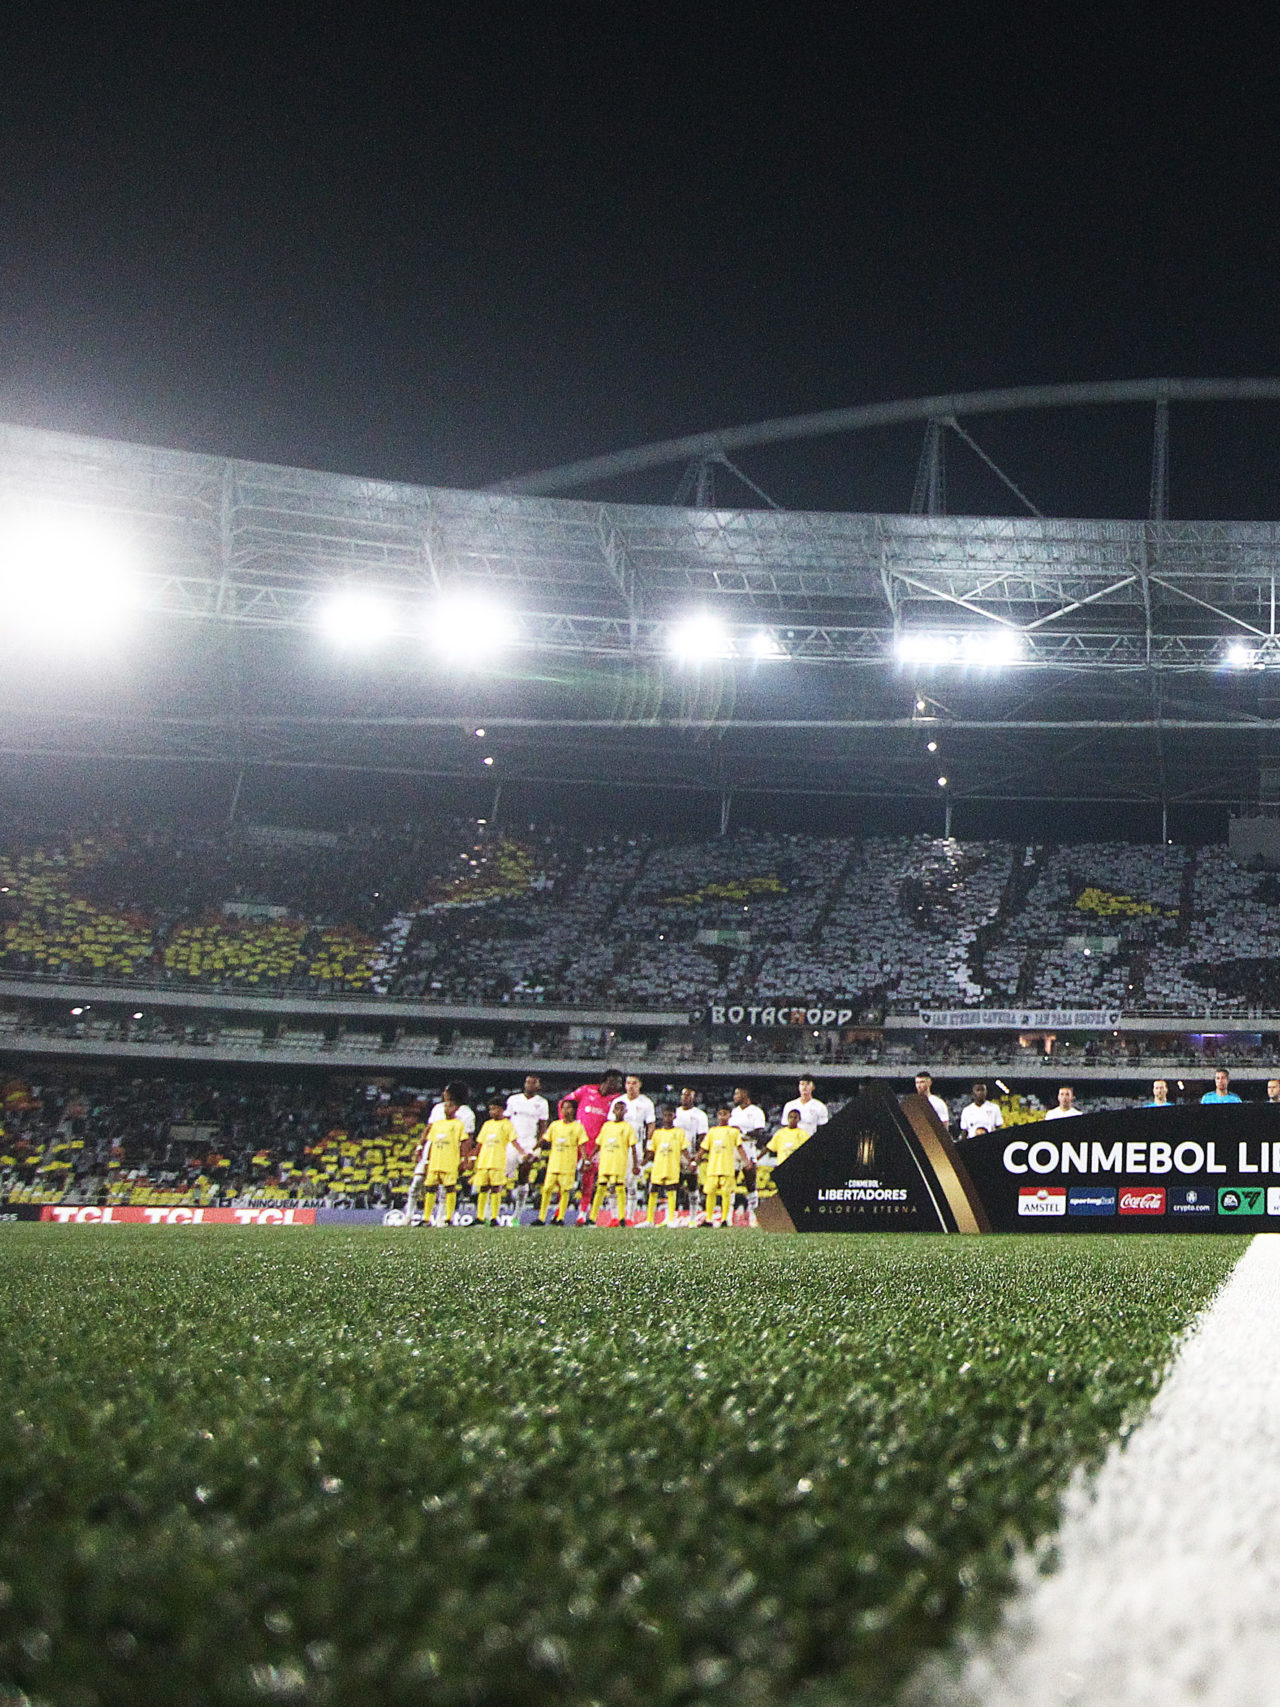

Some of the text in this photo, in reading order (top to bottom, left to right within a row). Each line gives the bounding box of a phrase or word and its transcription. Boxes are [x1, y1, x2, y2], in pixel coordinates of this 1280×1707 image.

[1003, 1141, 1227, 1174] CONMEBOL
[818, 1189, 907, 1200] LIBERTADORES
[52, 1206, 121, 1223] TCL
[144, 1207, 212, 1224] TCL
[234, 1208, 304, 1225] TCL
[1023, 1203, 1060, 1213] AMSTEL
[1173, 1203, 1210, 1213] crypto.com
